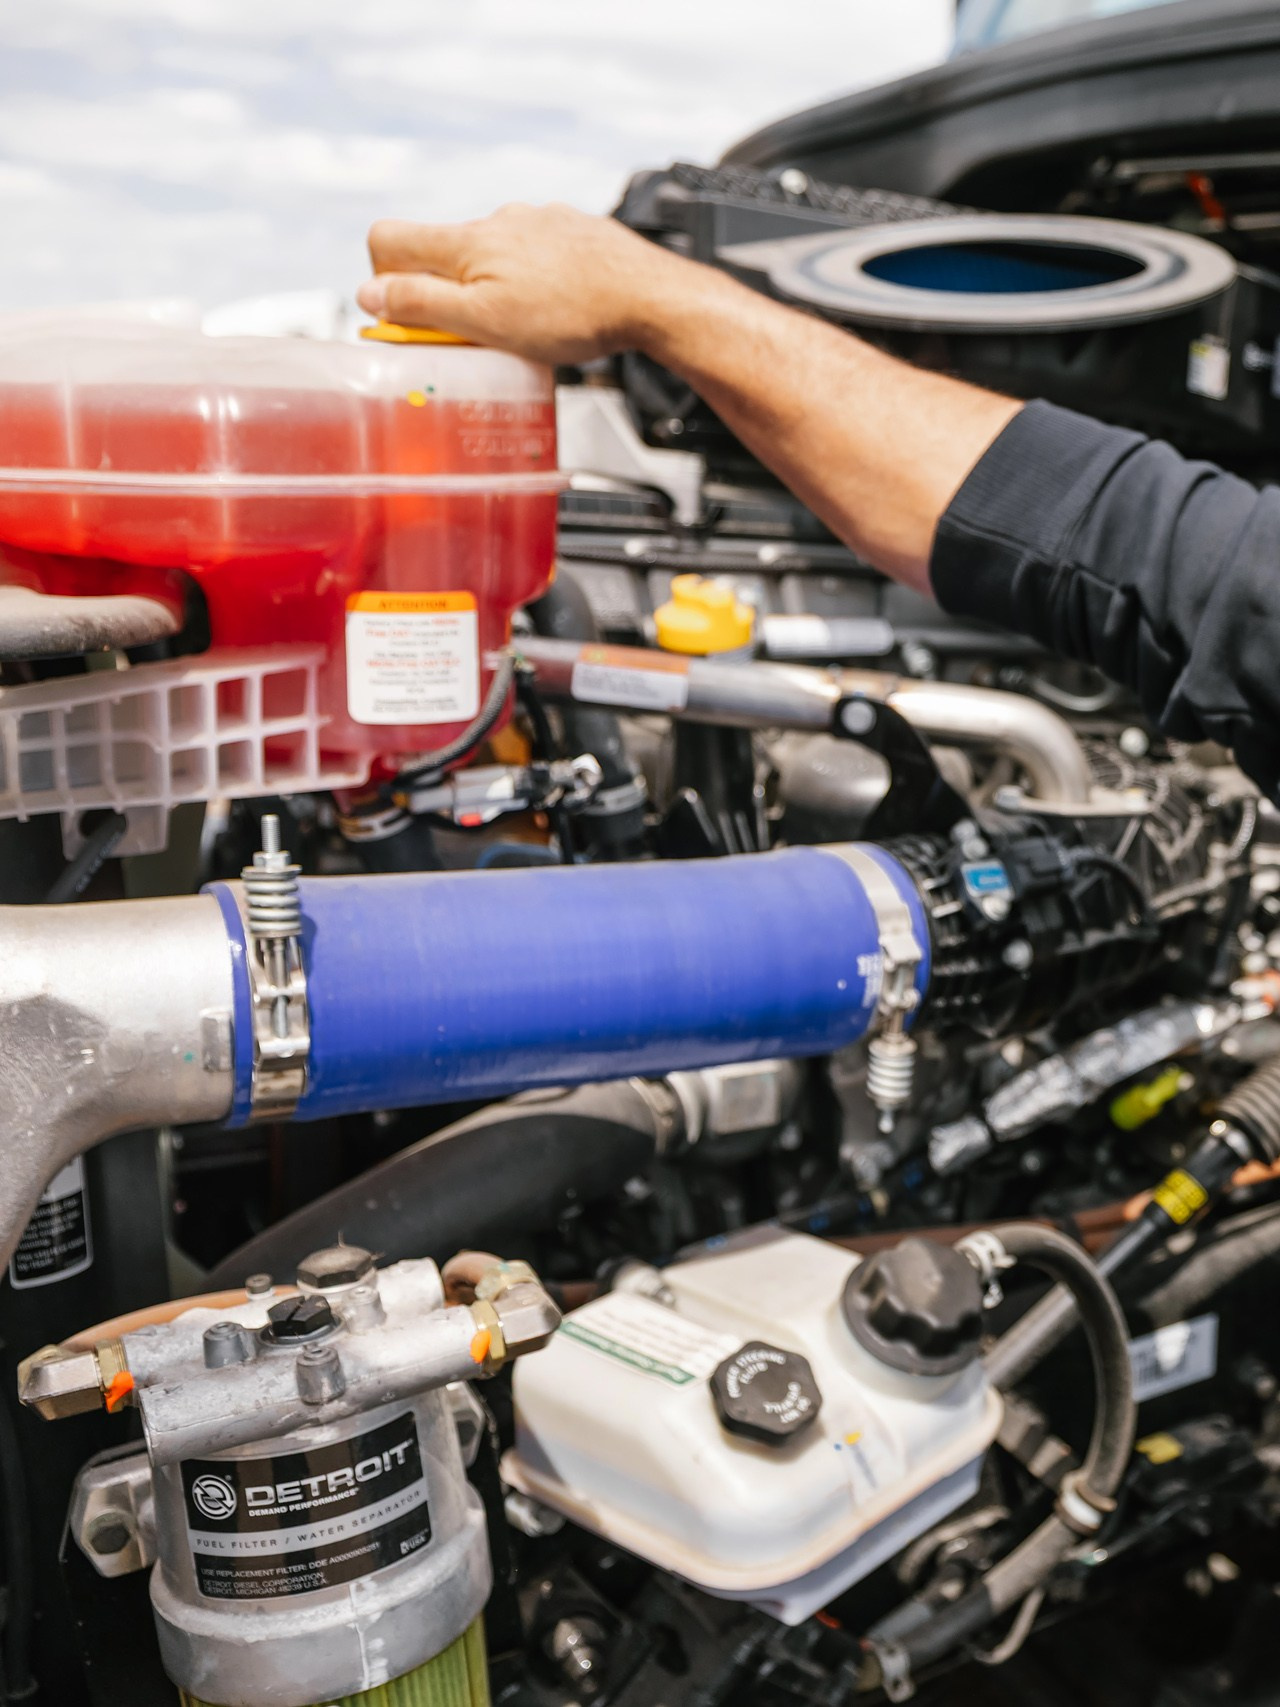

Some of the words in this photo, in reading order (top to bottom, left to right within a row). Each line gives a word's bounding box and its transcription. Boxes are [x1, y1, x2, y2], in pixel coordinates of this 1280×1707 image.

[244, 1440, 410, 1507] DETROIT
[248, 1505, 288, 1517] DEMAND
[289, 1490, 356, 1512] PERFORMANCE
[196, 1539, 225, 1549] FUEL
[231, 1538, 278, 1549] FILTER
[297, 1524, 345, 1542] WATER
[352, 1490, 421, 1528] SEPARATOR
[216, 1568, 275, 1578] REPLACEMENT
[262, 1572, 325, 1588] CORPORATION
